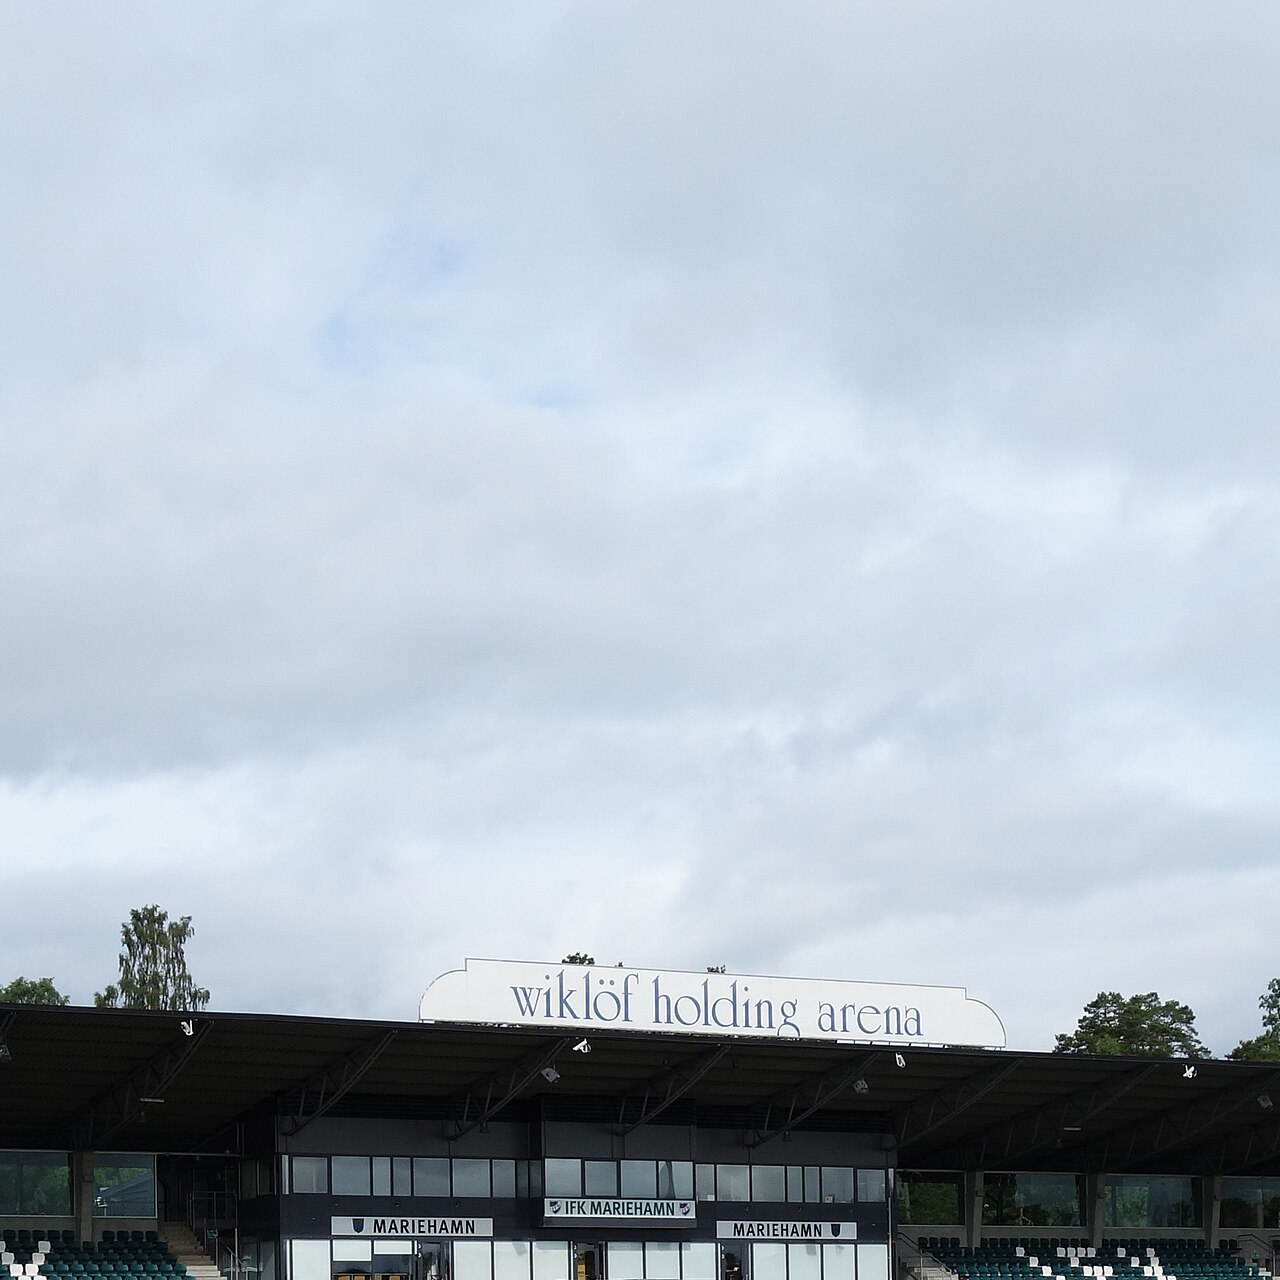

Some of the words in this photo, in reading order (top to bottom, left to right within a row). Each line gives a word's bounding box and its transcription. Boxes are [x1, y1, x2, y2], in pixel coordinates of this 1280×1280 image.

[510, 971, 639, 1024] wiklöf
[653, 976, 800, 1038] holding
[817, 1000, 924, 1037] arena
[565, 1200, 586, 1215] IFK
[590, 1201, 675, 1216] MARIEHAMN
[373, 1218, 476, 1235] MARIEHAMN
[733, 1222, 822, 1238] MARIEHAMN
